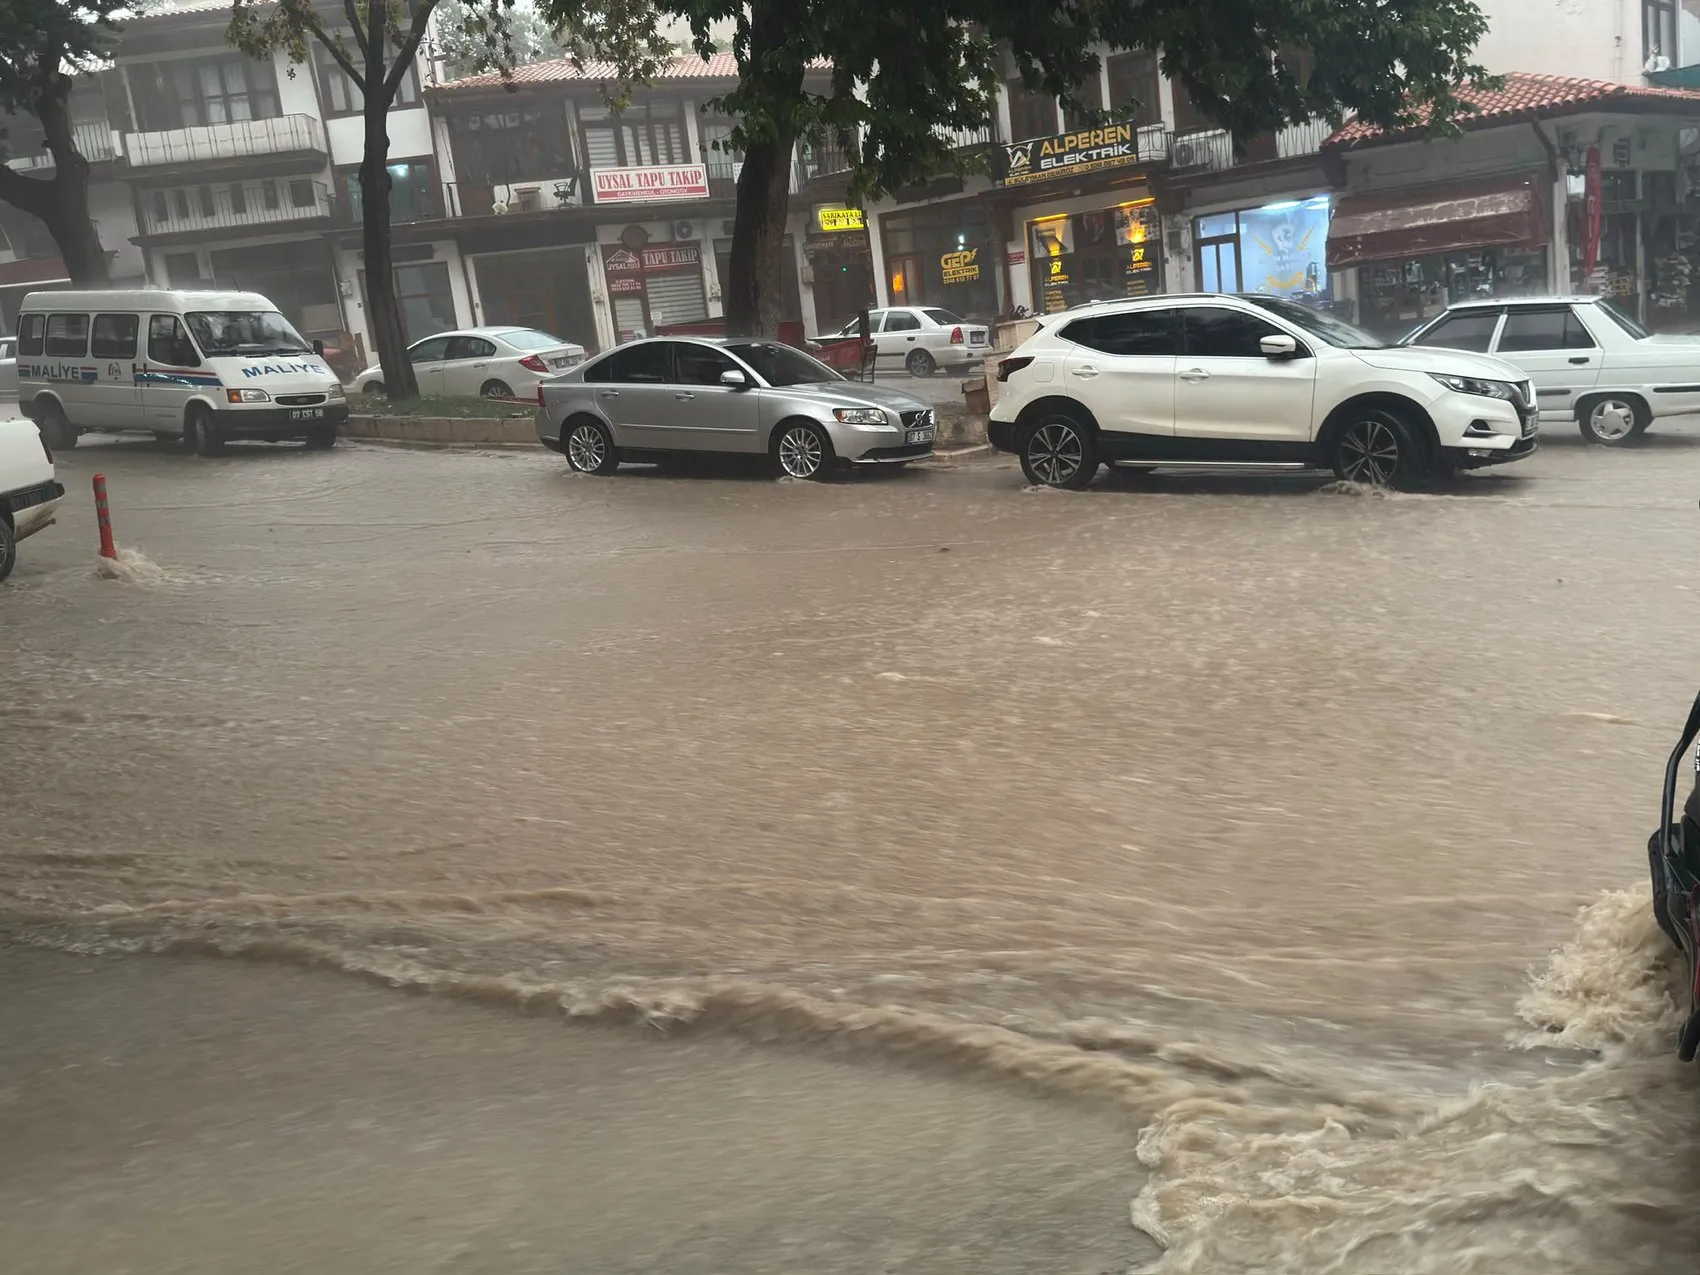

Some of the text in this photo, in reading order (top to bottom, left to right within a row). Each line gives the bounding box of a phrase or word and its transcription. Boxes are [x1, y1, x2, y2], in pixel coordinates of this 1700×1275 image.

[1040, 124, 1131, 156] ALPEREN
[1040, 143, 1131, 169] ELEKTRİK
[598, 169, 702, 190] UYSAL TAPU TAKİP
[822, 211, 854, 219] SARIKAYA
[643, 249, 699, 266] TAPU TAKİP
[940, 250, 972, 269] GEP
[607, 263, 627, 271] UYSAL
[31, 362, 80, 379] MALİYE
[241, 362, 325, 378] MALİYE
